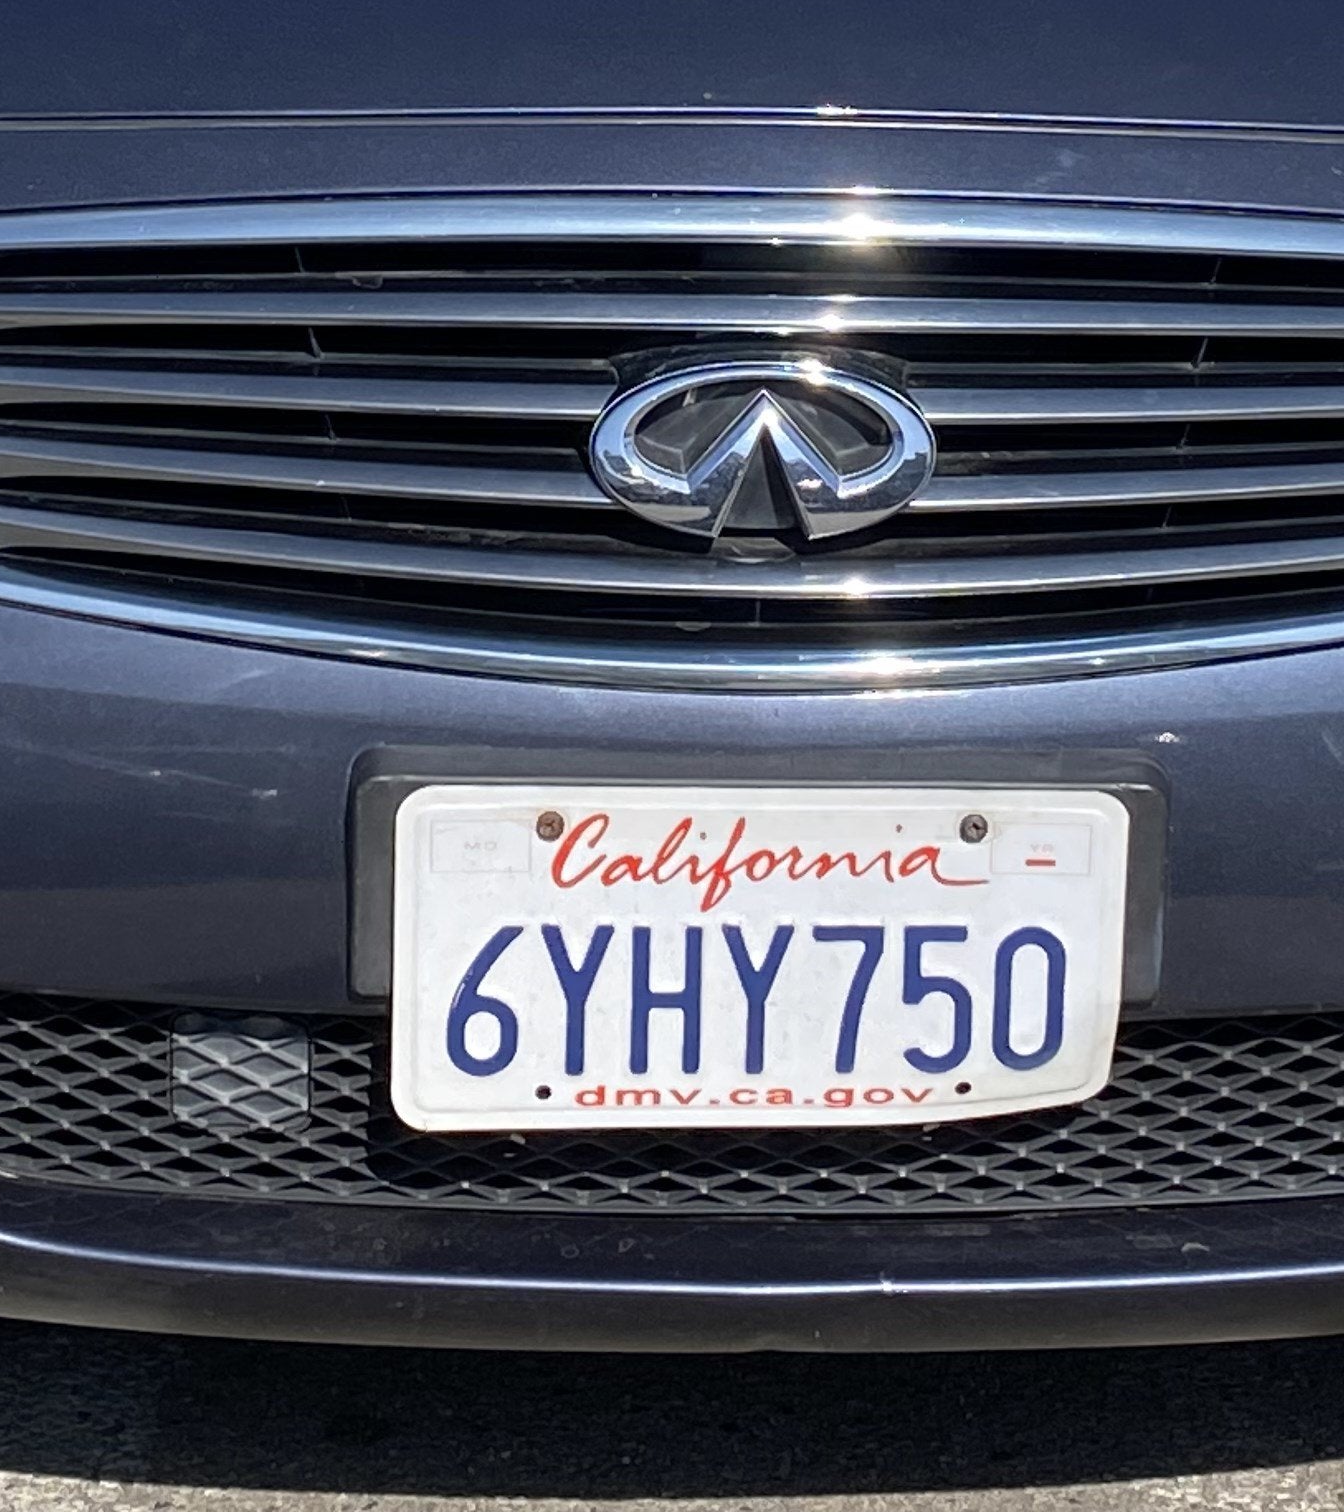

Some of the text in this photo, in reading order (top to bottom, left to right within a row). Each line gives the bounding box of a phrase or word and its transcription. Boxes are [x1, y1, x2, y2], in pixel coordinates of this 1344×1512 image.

[552, 813, 989, 912] California
[446, 925, 1068, 1077] 6YHY750
[574, 1085, 934, 1109] dmv.ca.gov
